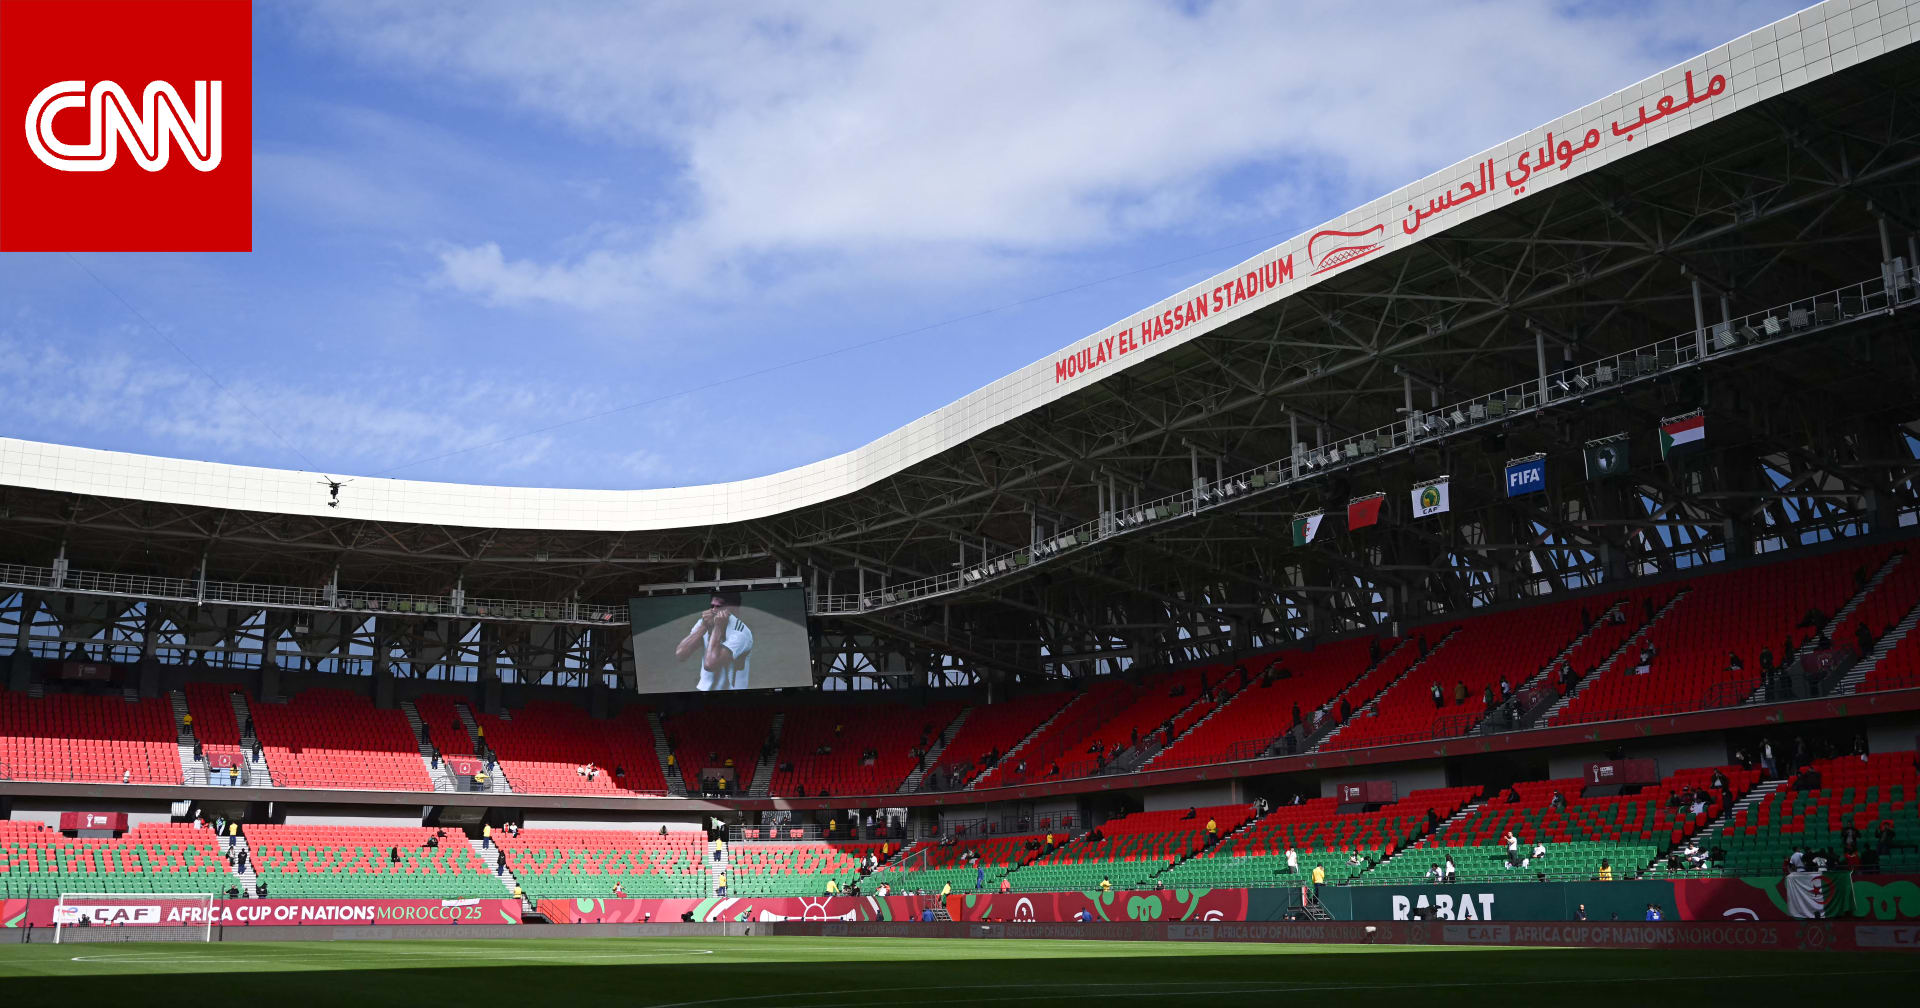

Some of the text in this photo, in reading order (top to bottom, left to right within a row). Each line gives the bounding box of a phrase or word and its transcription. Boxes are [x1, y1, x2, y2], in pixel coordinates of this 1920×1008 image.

[1403, 71, 1726, 234] ملعب مولاي الحسن
[1056, 254, 1294, 384] MOULAY EL HASSAN STADIUM
[1510, 468, 1540, 488] FIFA
[95, 905, 482, 922] CAF AFRICA CUP OF NATIONS MOROCCO 25
[1468, 927, 1504, 940] CAF
[1515, 926, 1561, 942] AFRICA
[1563, 927, 1591, 943] CUP
[1591, 927, 1611, 943] OF
[1613, 927, 1676, 944] NATIONS
[1677, 928, 1758, 945] MOROCCO
[1761, 928, 1778, 945] 25
